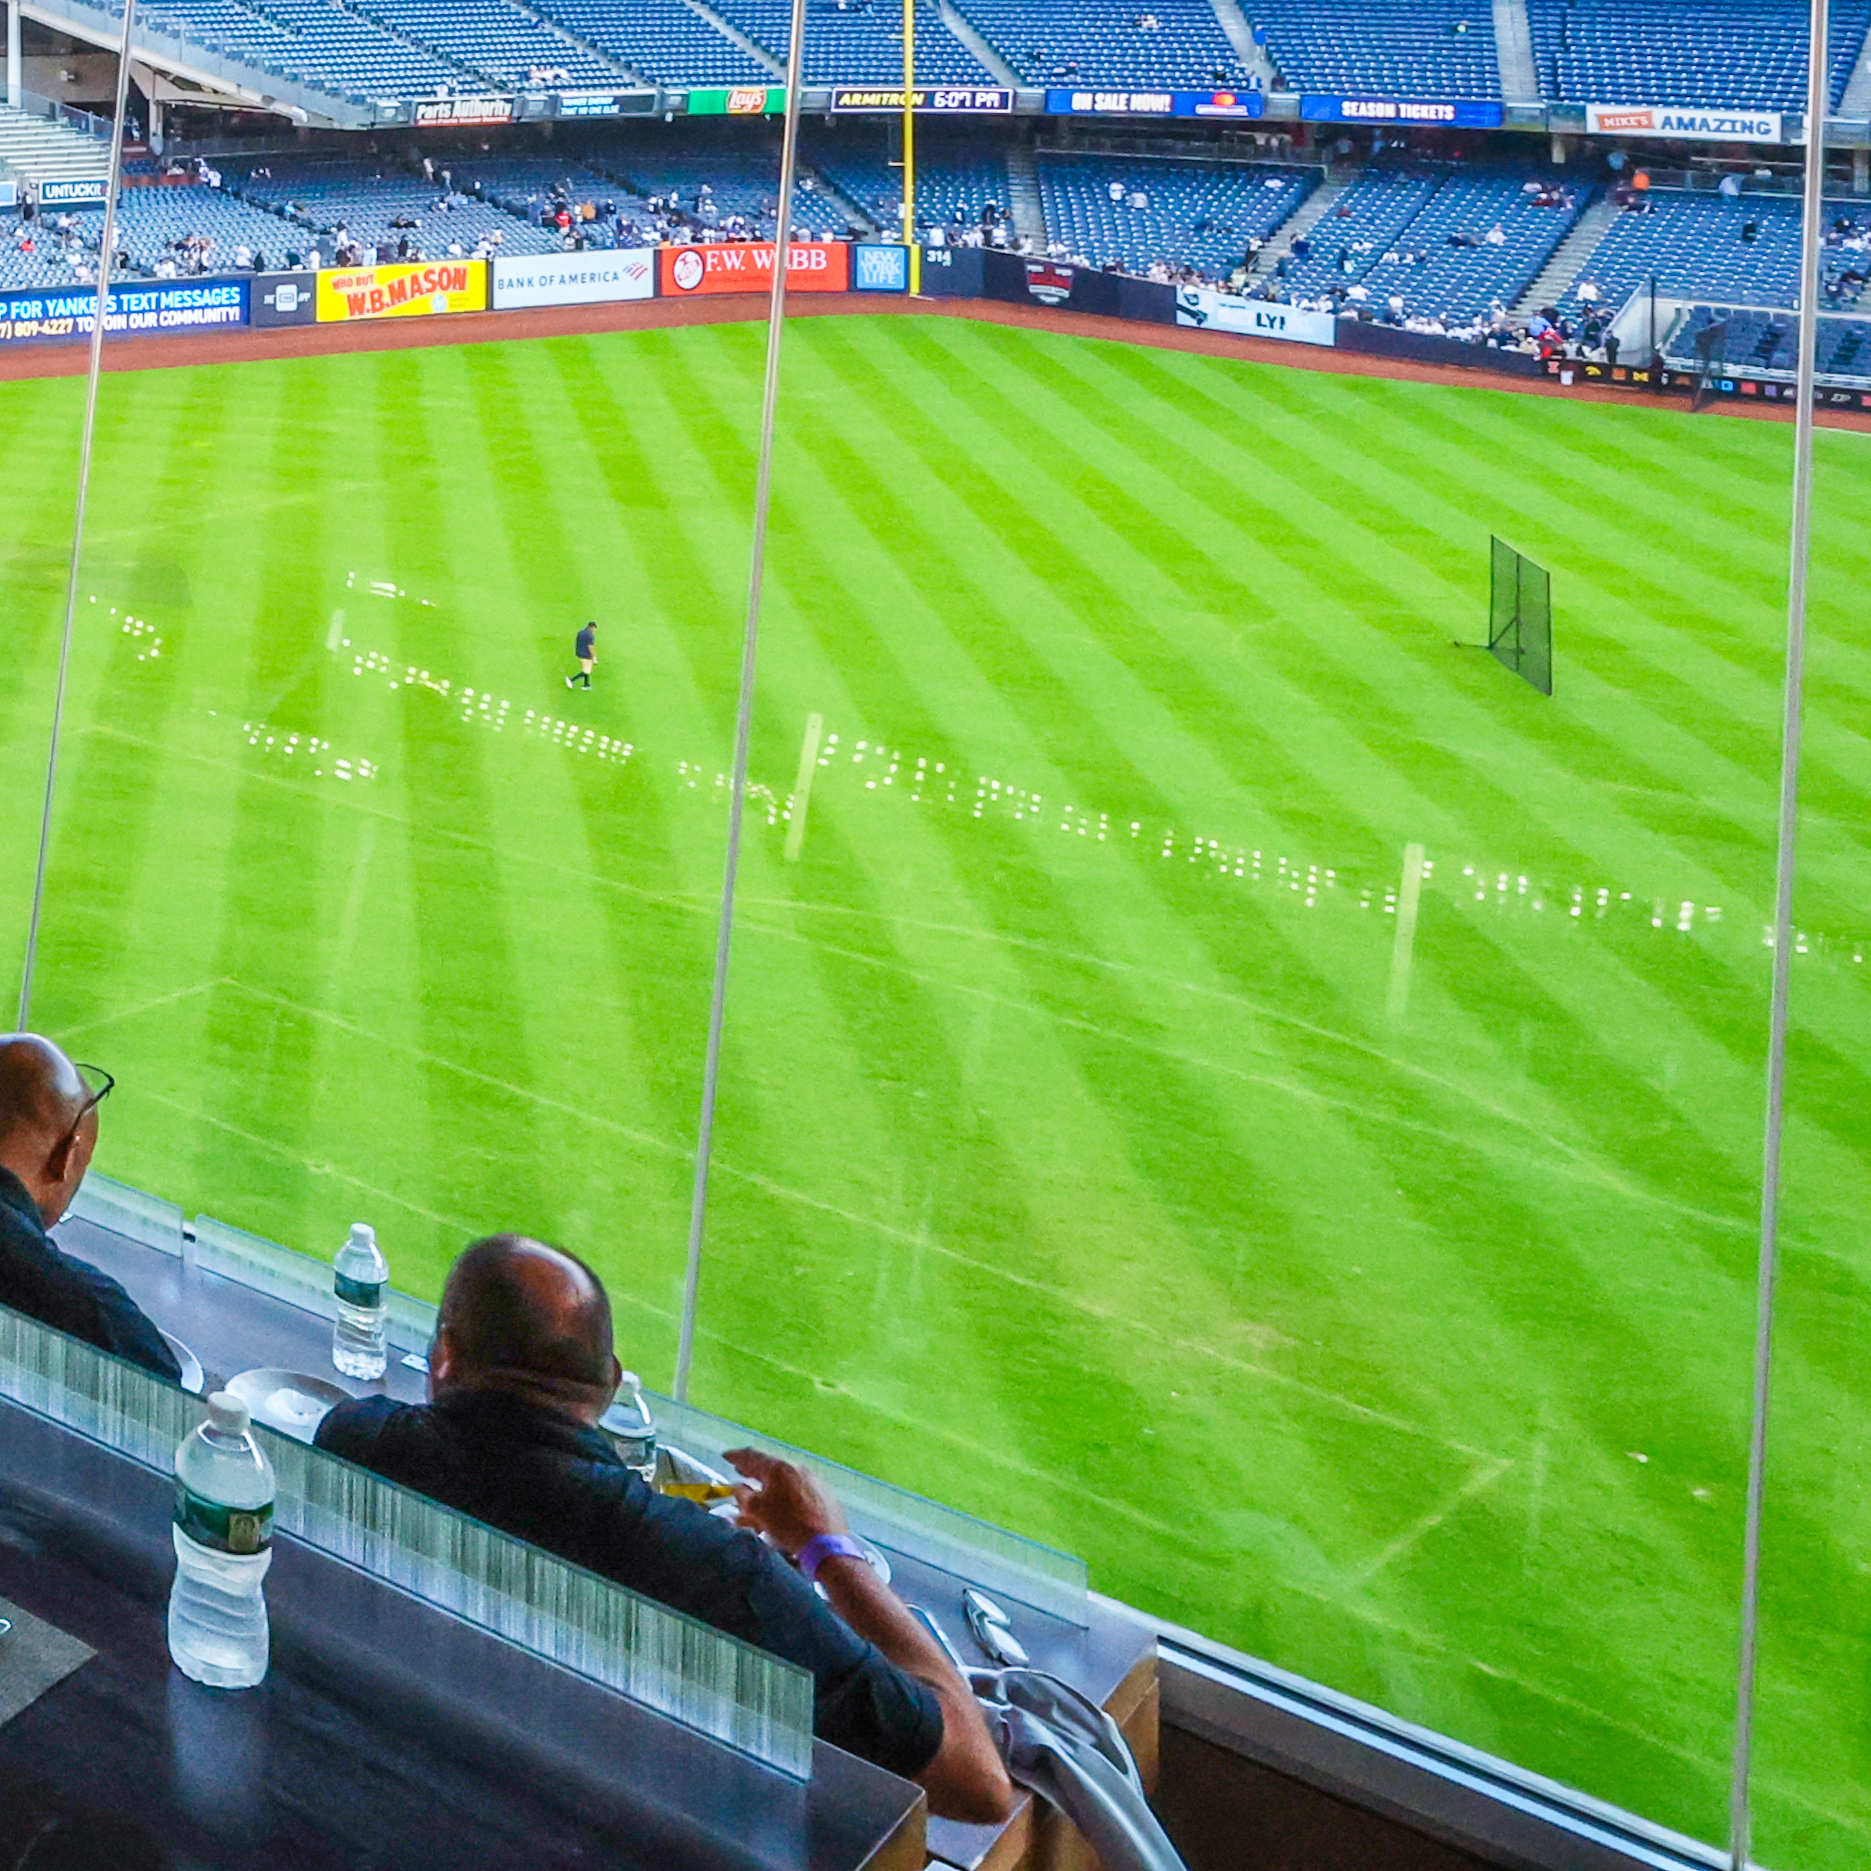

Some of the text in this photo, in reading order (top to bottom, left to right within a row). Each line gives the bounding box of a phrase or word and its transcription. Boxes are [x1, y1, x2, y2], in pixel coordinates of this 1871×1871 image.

[416, 98, 513, 120] Parts Authority
[933, 91, 971, 107] 6:07
[974, 92, 1000, 106] PM
[1071, 93, 1172, 112] ON SALE NOW!
[1341, 101, 1455, 121] SEASON TICKETS
[1602, 115, 1649, 128] MIKE'S
[1660, 115, 1773, 136] AMAZING
[705, 249, 746, 272] F.W.
[926, 250, 952, 263] 314
[860, 250, 901, 285] NEW YORK LIFE
[332, 278, 352, 290] WHO
[497, 271, 620, 290] BANK OF AMERICA
[346, 266, 468, 317] W.B.MASON
[10, 300, 43, 320] FOR
[119, 292, 159, 311] TEXT
[160, 286, 241, 309] MESSAGES
[14, 317, 75, 339] 809-4227
[76, 316, 94, 333] TO
[103, 313, 128, 332] OIN
[128, 311, 158, 329] OUR
[159, 306, 241, 327] COMMUNITY!
